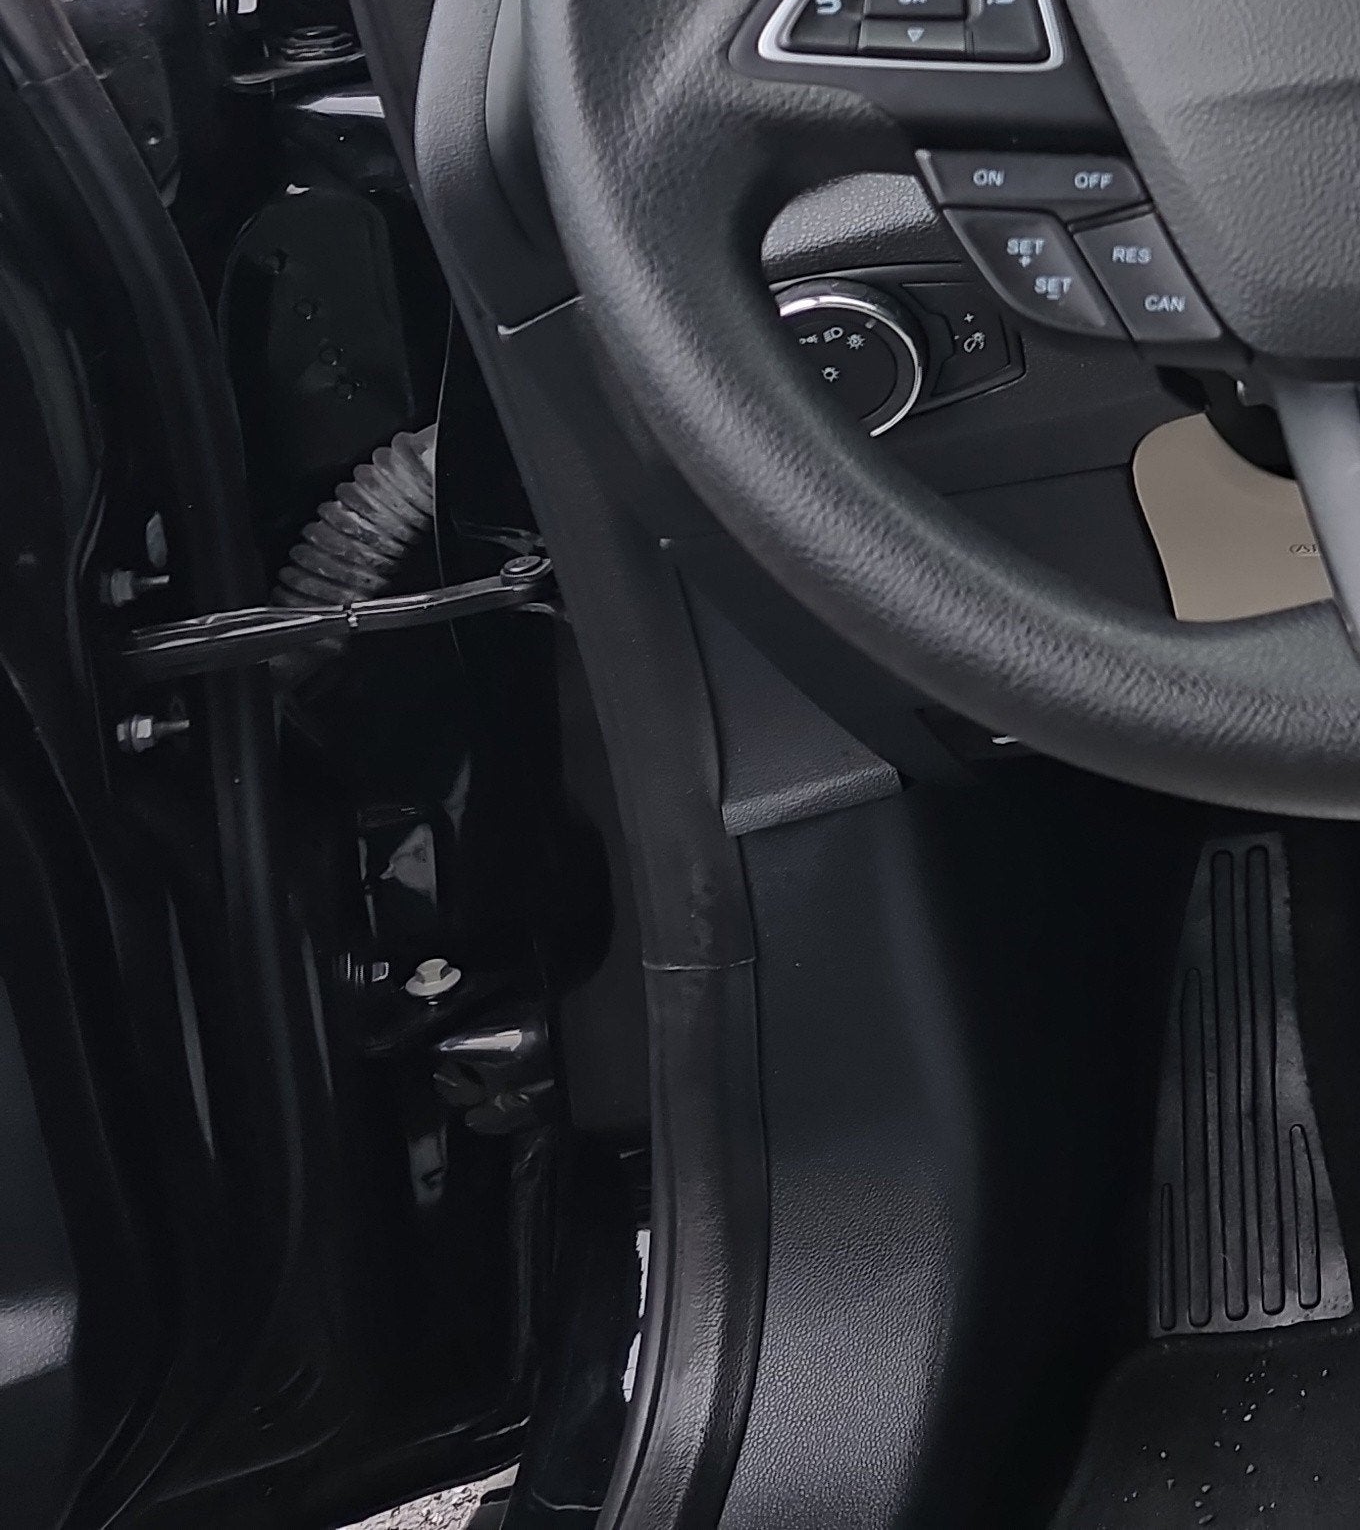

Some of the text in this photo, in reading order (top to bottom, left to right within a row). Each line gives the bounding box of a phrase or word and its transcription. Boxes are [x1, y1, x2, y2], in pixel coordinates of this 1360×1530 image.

[972, 169, 1114, 189] ON OFF
[1006, 237, 1046, 256] SET
[1112, 245, 1151, 264] RES
[1033, 276, 1072, 295] SET
[1144, 294, 1187, 313] CAN
